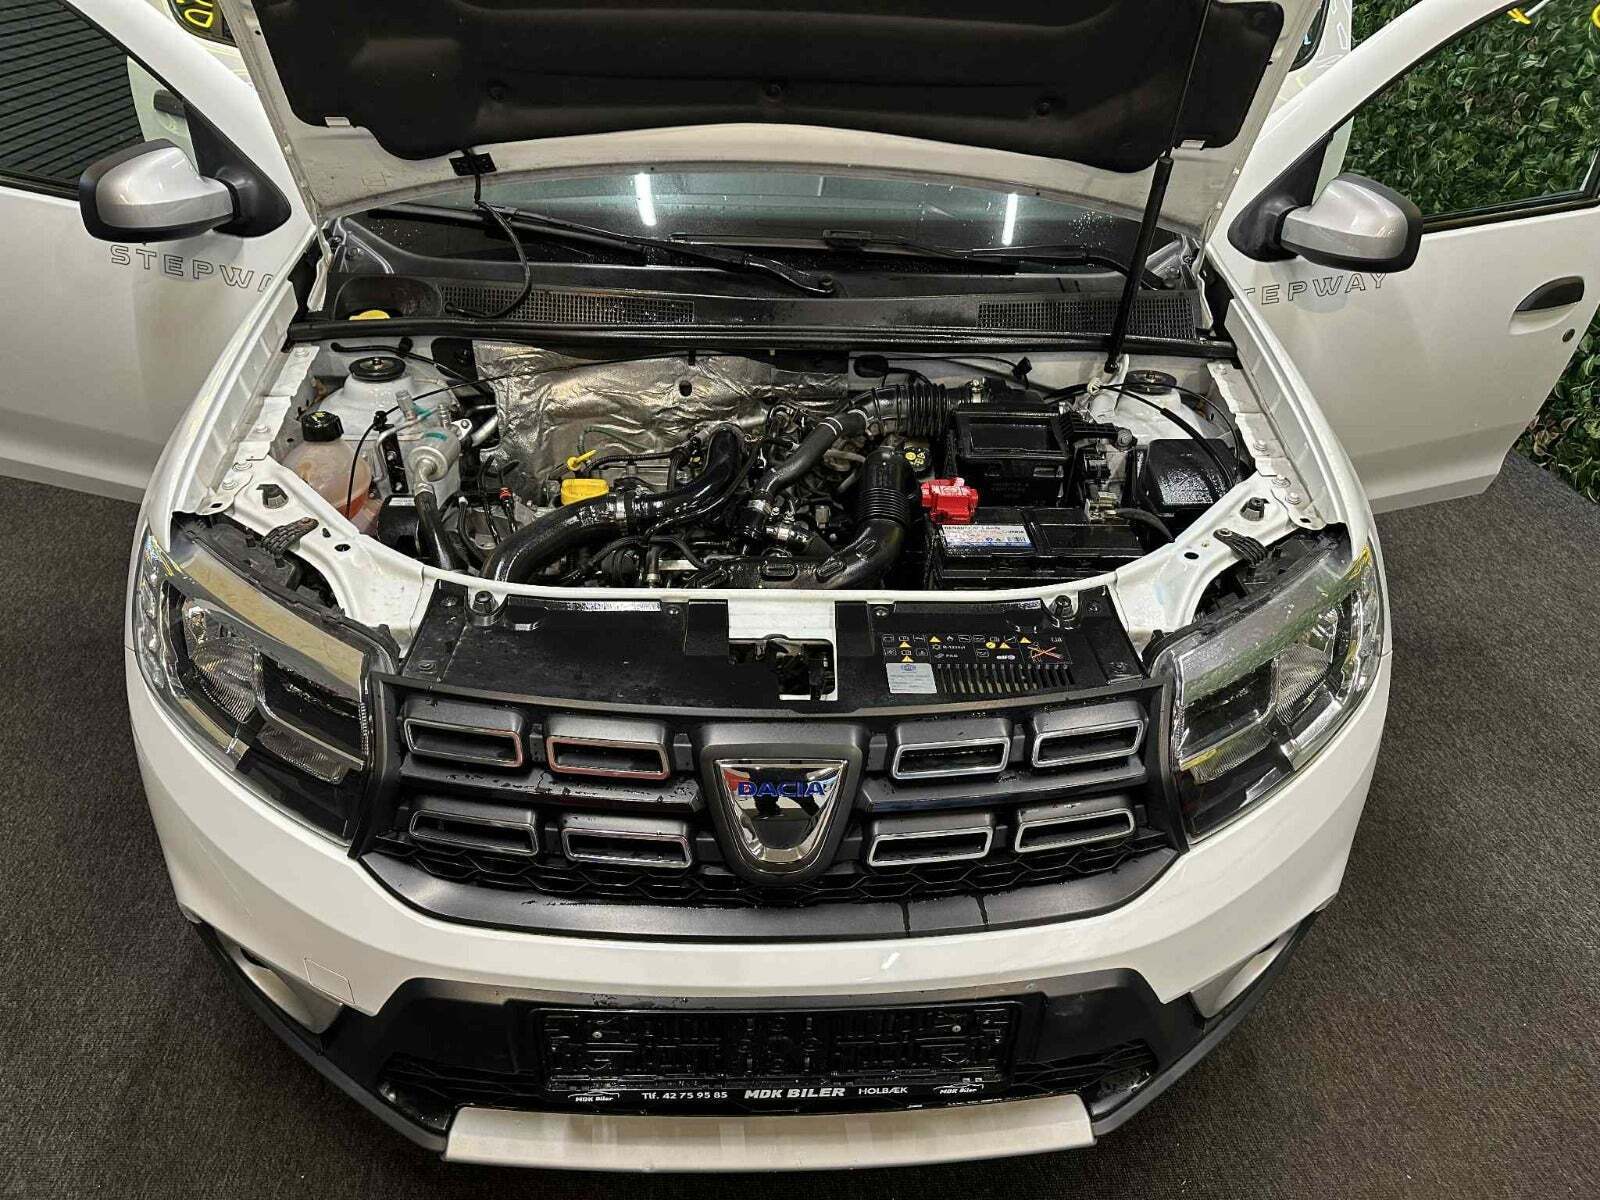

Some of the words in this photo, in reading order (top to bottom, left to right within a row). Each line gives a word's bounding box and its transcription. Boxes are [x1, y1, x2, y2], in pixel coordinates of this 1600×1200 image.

[737, 781, 825, 797] DACIA
[642, 1092, 660, 1100] Tlf.
[713, 1091, 728, 1099] 85
[744, 1089, 782, 1099] MDK
[786, 1087, 846, 1098] BILER
[858, 1087, 908, 1095] HOLBÆK
